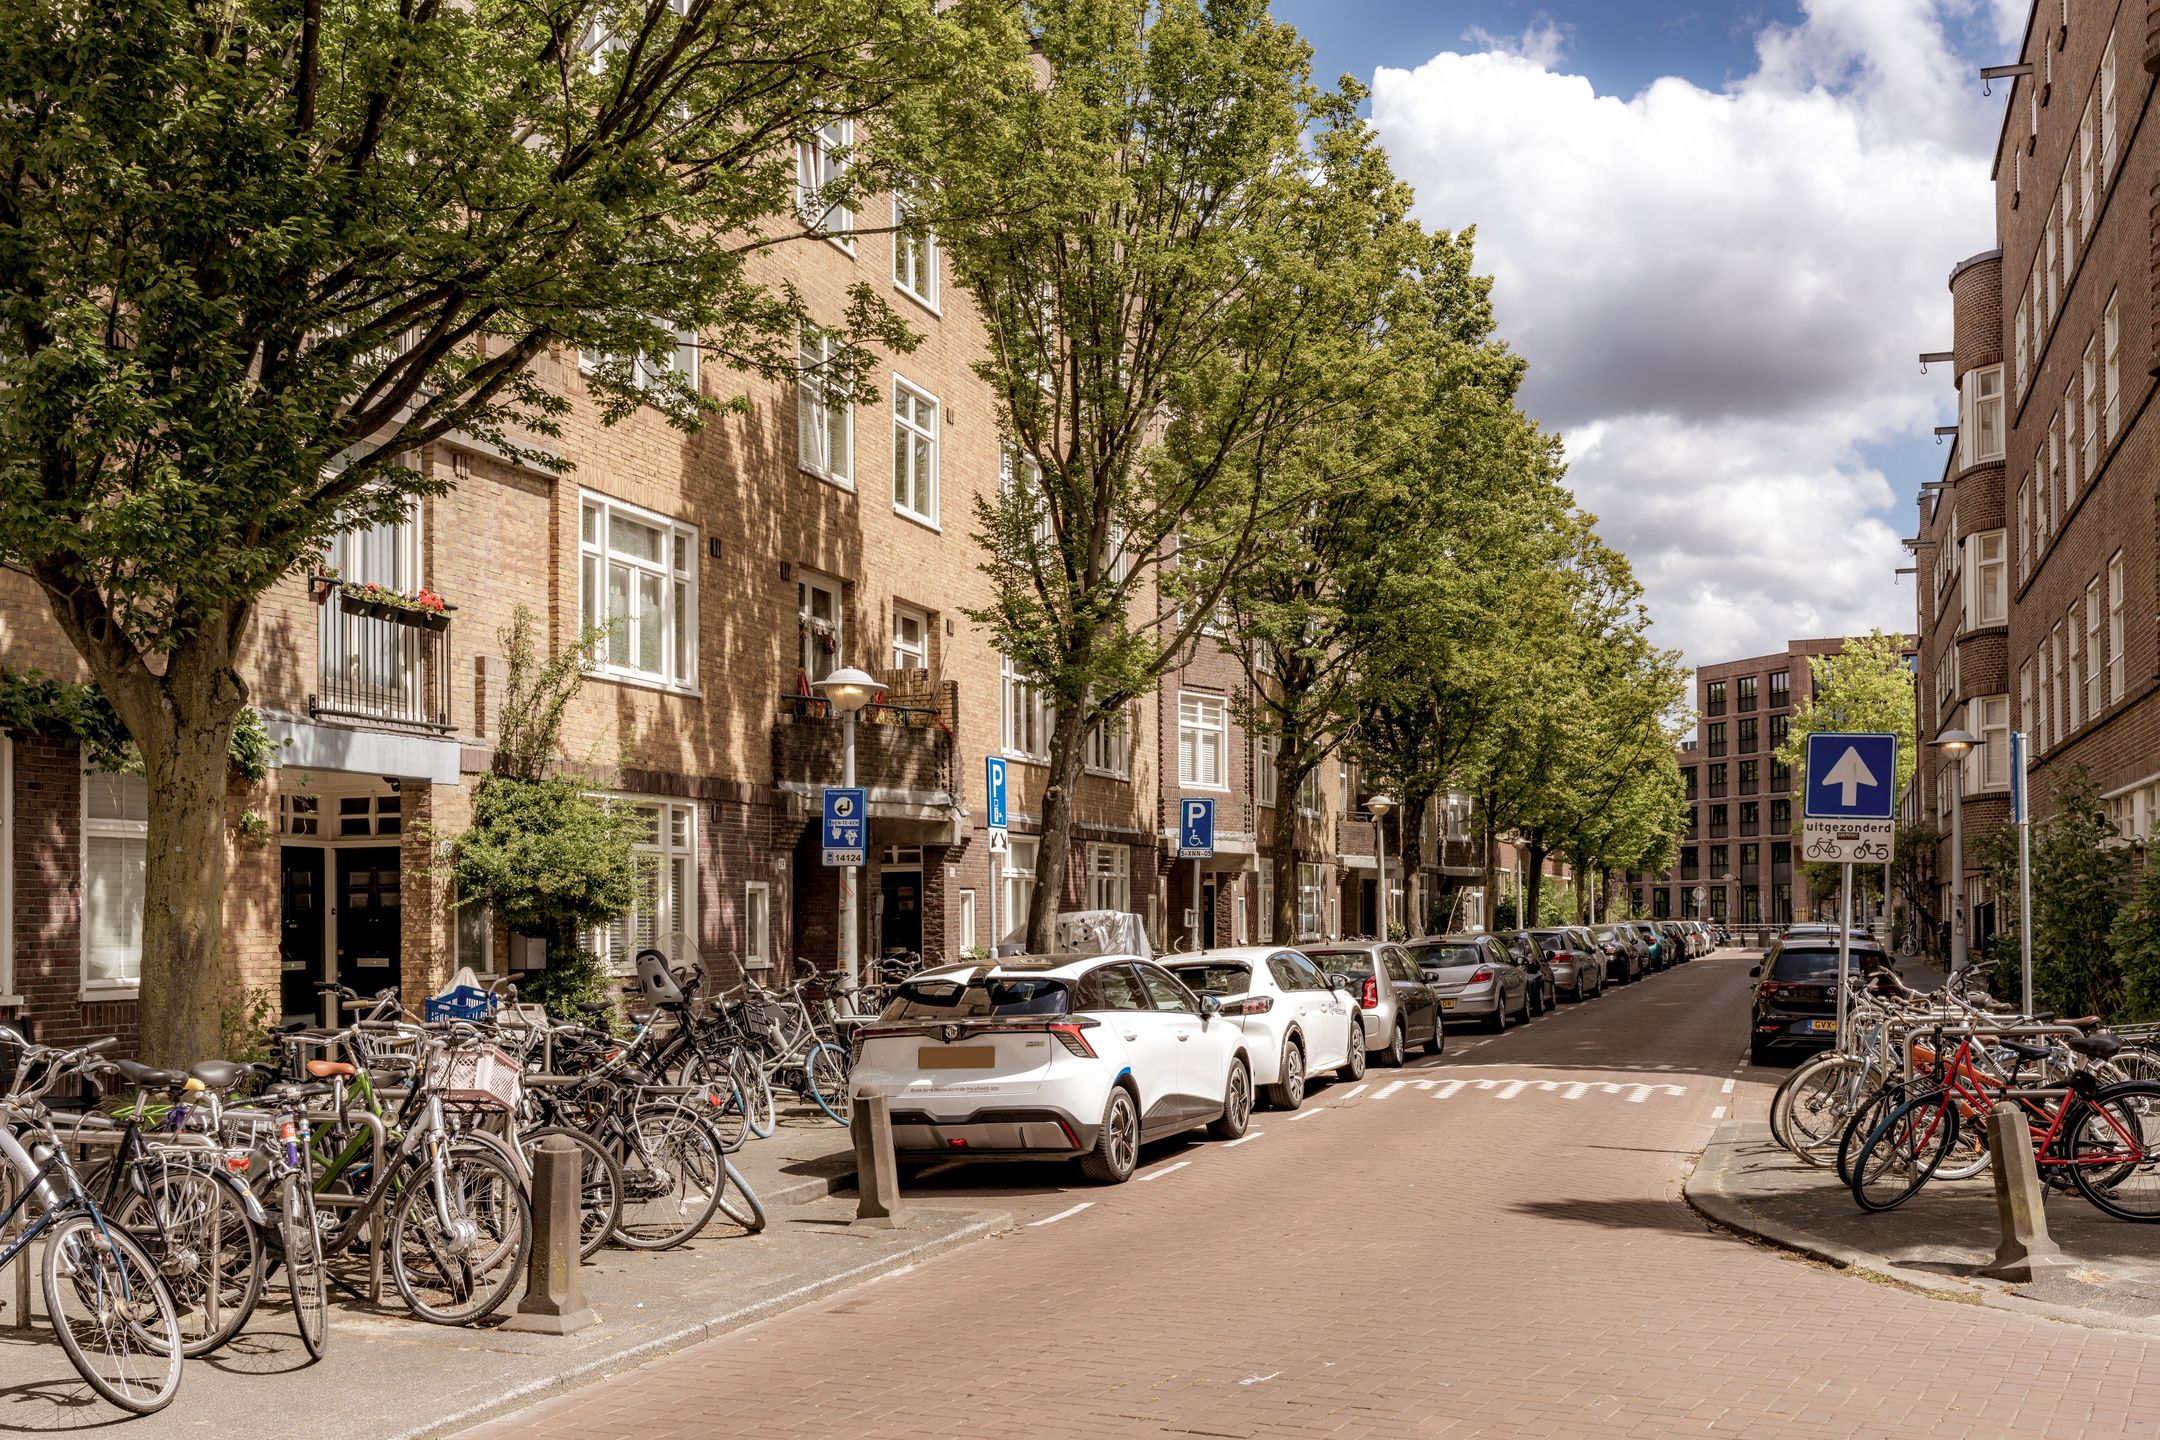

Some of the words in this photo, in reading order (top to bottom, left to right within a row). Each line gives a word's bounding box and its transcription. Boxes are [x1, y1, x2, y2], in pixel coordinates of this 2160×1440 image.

[992, 763, 1003, 798] P
[1187, 802, 1206, 828] P
[1806, 822, 1891, 834] uitgezonderd
[835, 854, 861, 862] 14124
